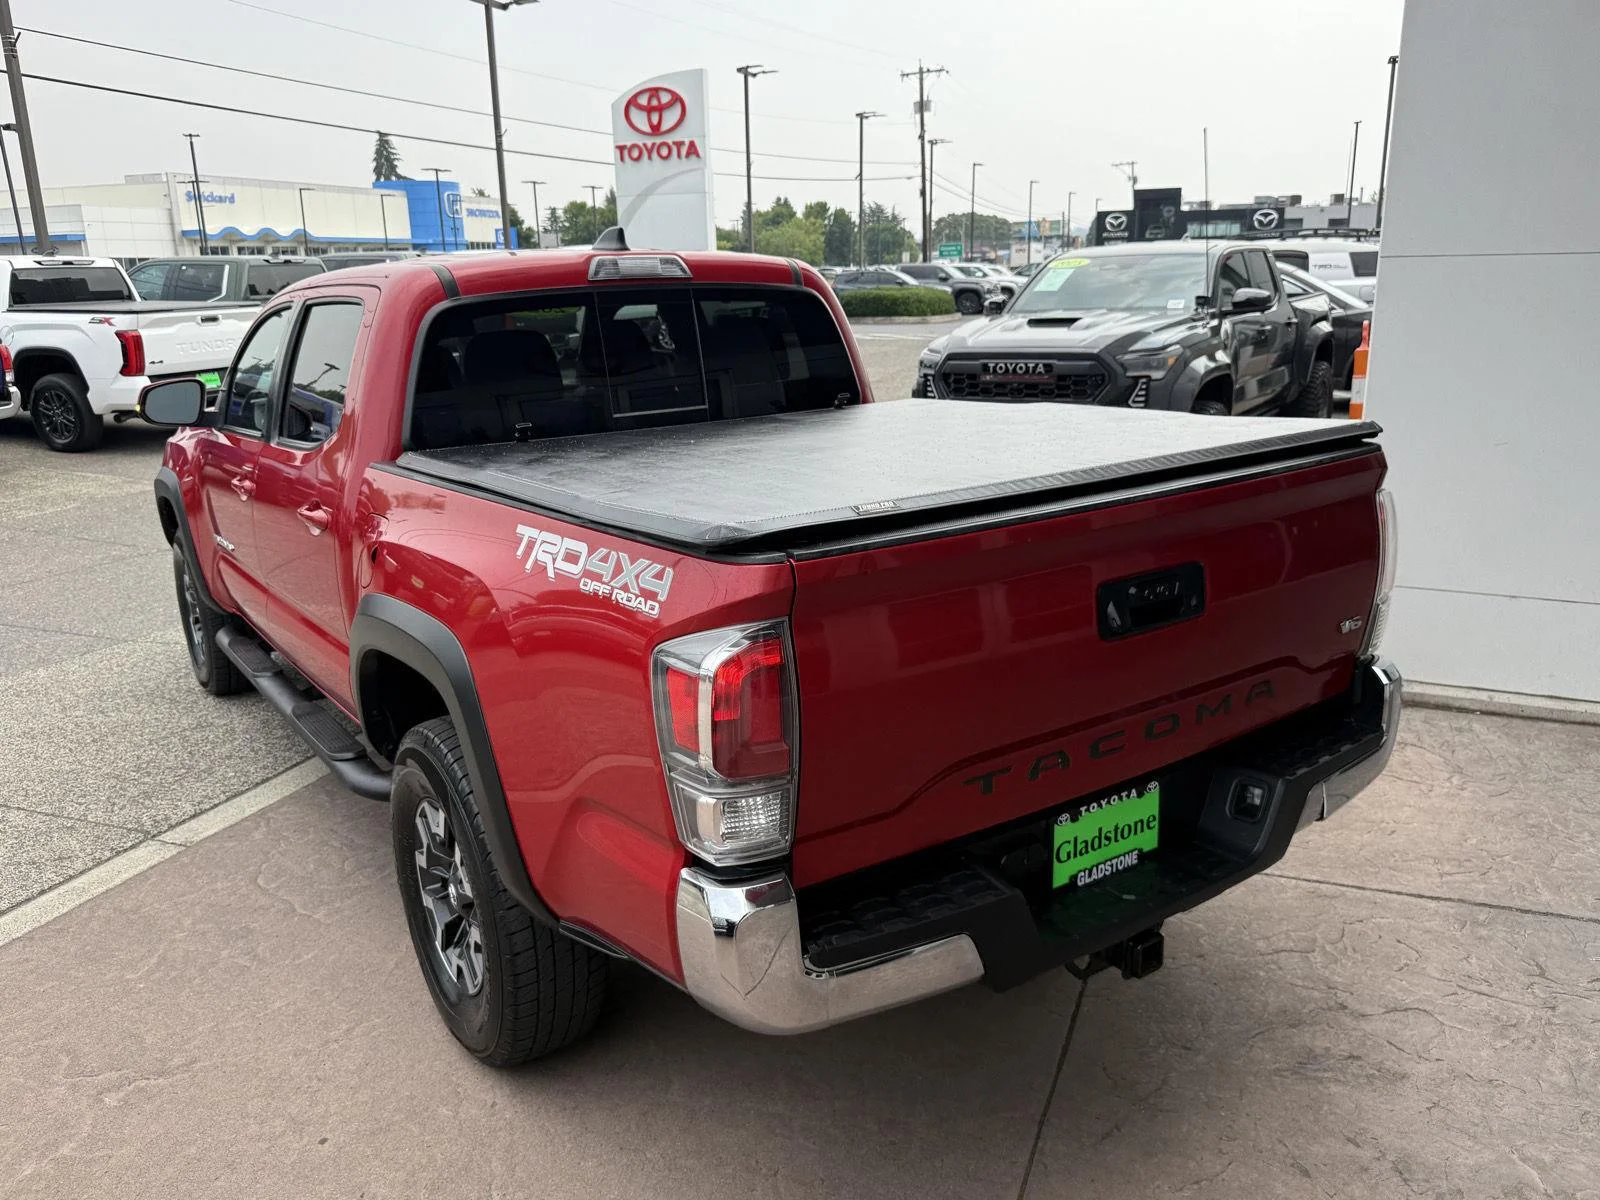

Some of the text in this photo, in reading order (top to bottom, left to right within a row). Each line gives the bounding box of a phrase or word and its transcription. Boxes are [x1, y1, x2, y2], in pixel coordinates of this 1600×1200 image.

[615, 140, 702, 163] TOYOTA
[175, 338, 242, 355] TUNDR
[987, 362, 1046, 375] TOYOTA
[516, 524, 674, 602] TRD 4X4
[579, 578, 661, 619] OFF ROAD
[962, 679, 1275, 795] TACOMA
[1079, 788, 1138, 817] TOYOTA
[1055, 813, 1157, 864] Gladstone
[1076, 849, 1139, 887] GLADSTONE
